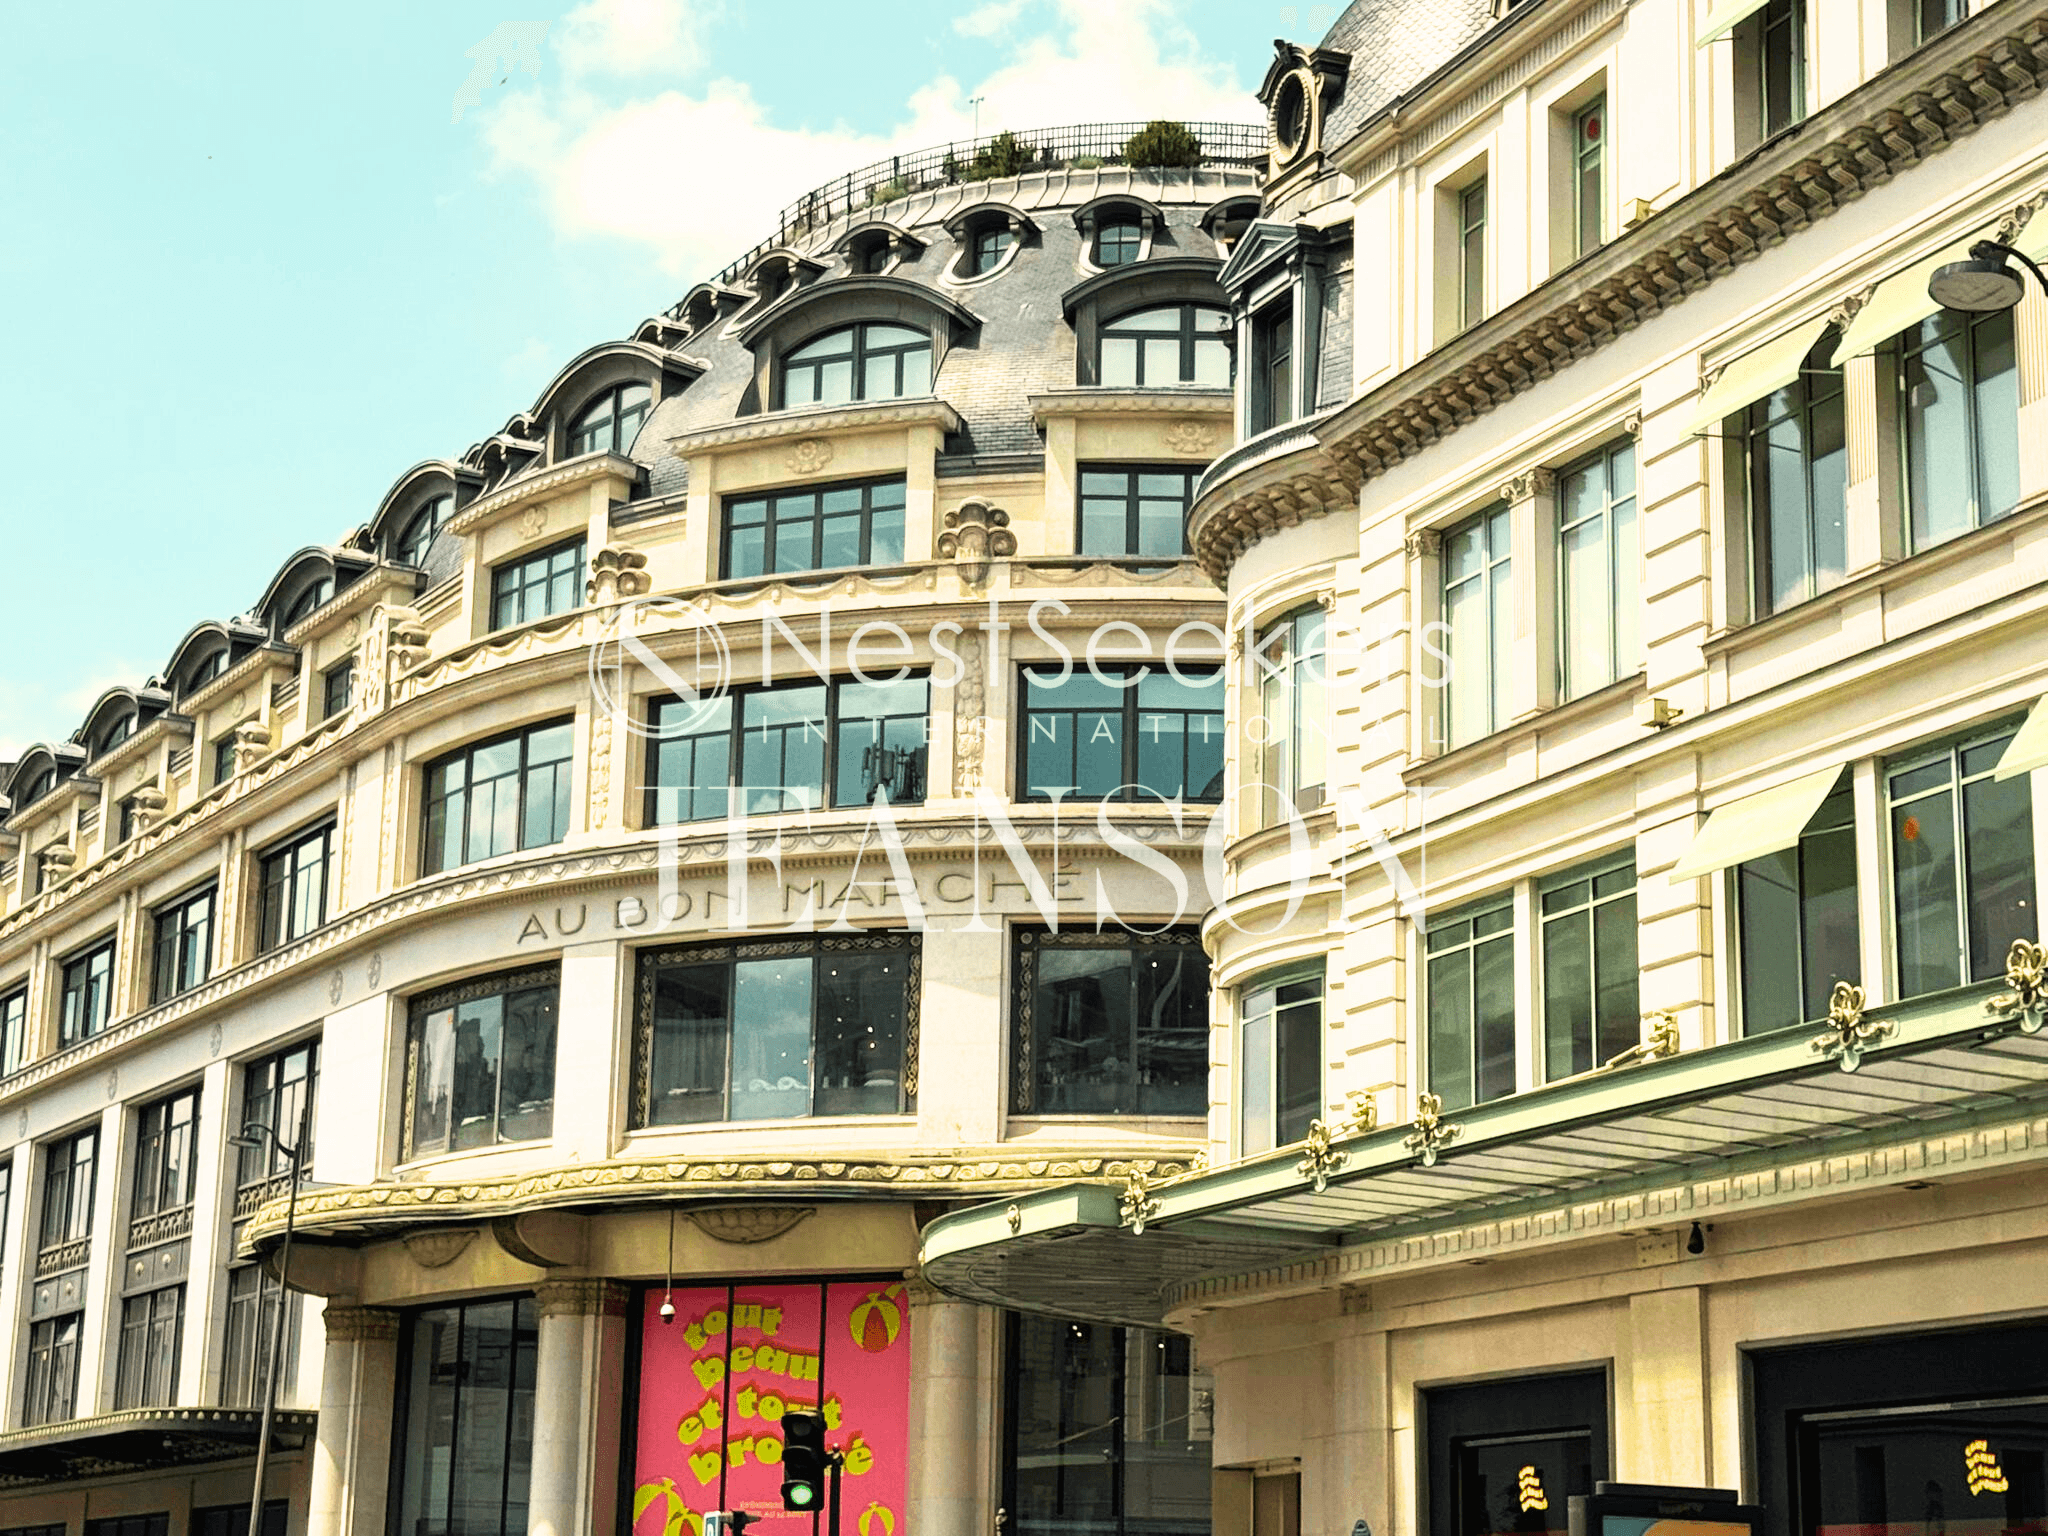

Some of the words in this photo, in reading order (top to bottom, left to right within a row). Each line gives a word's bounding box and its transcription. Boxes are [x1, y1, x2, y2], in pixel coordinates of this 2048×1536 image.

[517, 904, 587, 944] AU
[615, 886, 742, 929] BON
[782, 862, 1085, 912] MARCHÉ
[690, 1345, 819, 1391] beau
[736, 1386, 843, 1431] tot
[688, 1435, 875, 1486] broé
